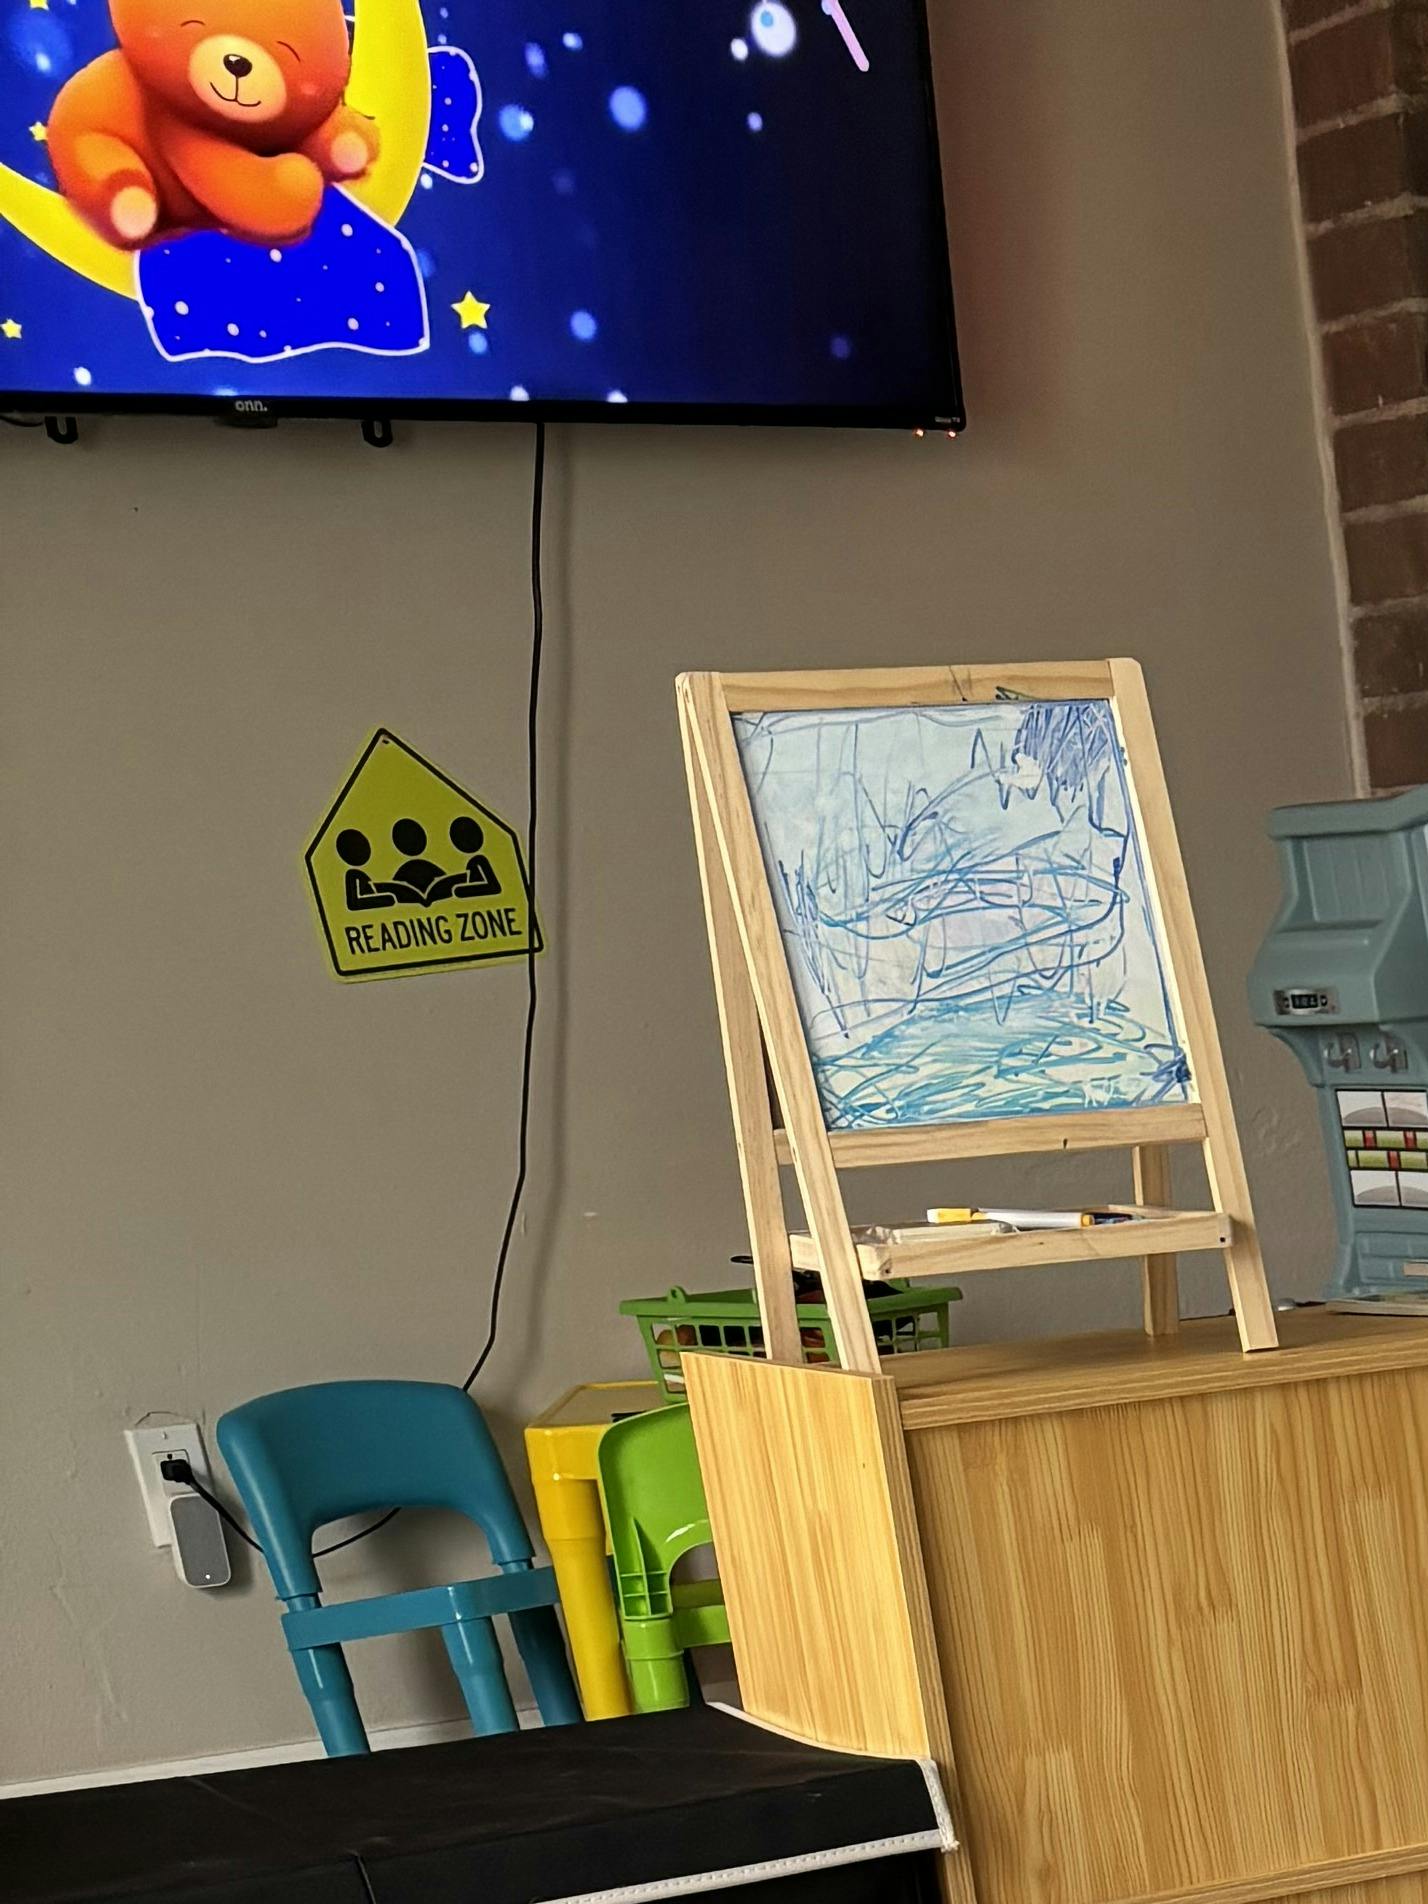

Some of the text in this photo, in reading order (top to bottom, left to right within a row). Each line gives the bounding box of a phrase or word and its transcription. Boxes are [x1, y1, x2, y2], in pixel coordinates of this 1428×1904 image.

[235, 400, 268, 412] onn.
[344, 908, 523, 955] READING ZONE
